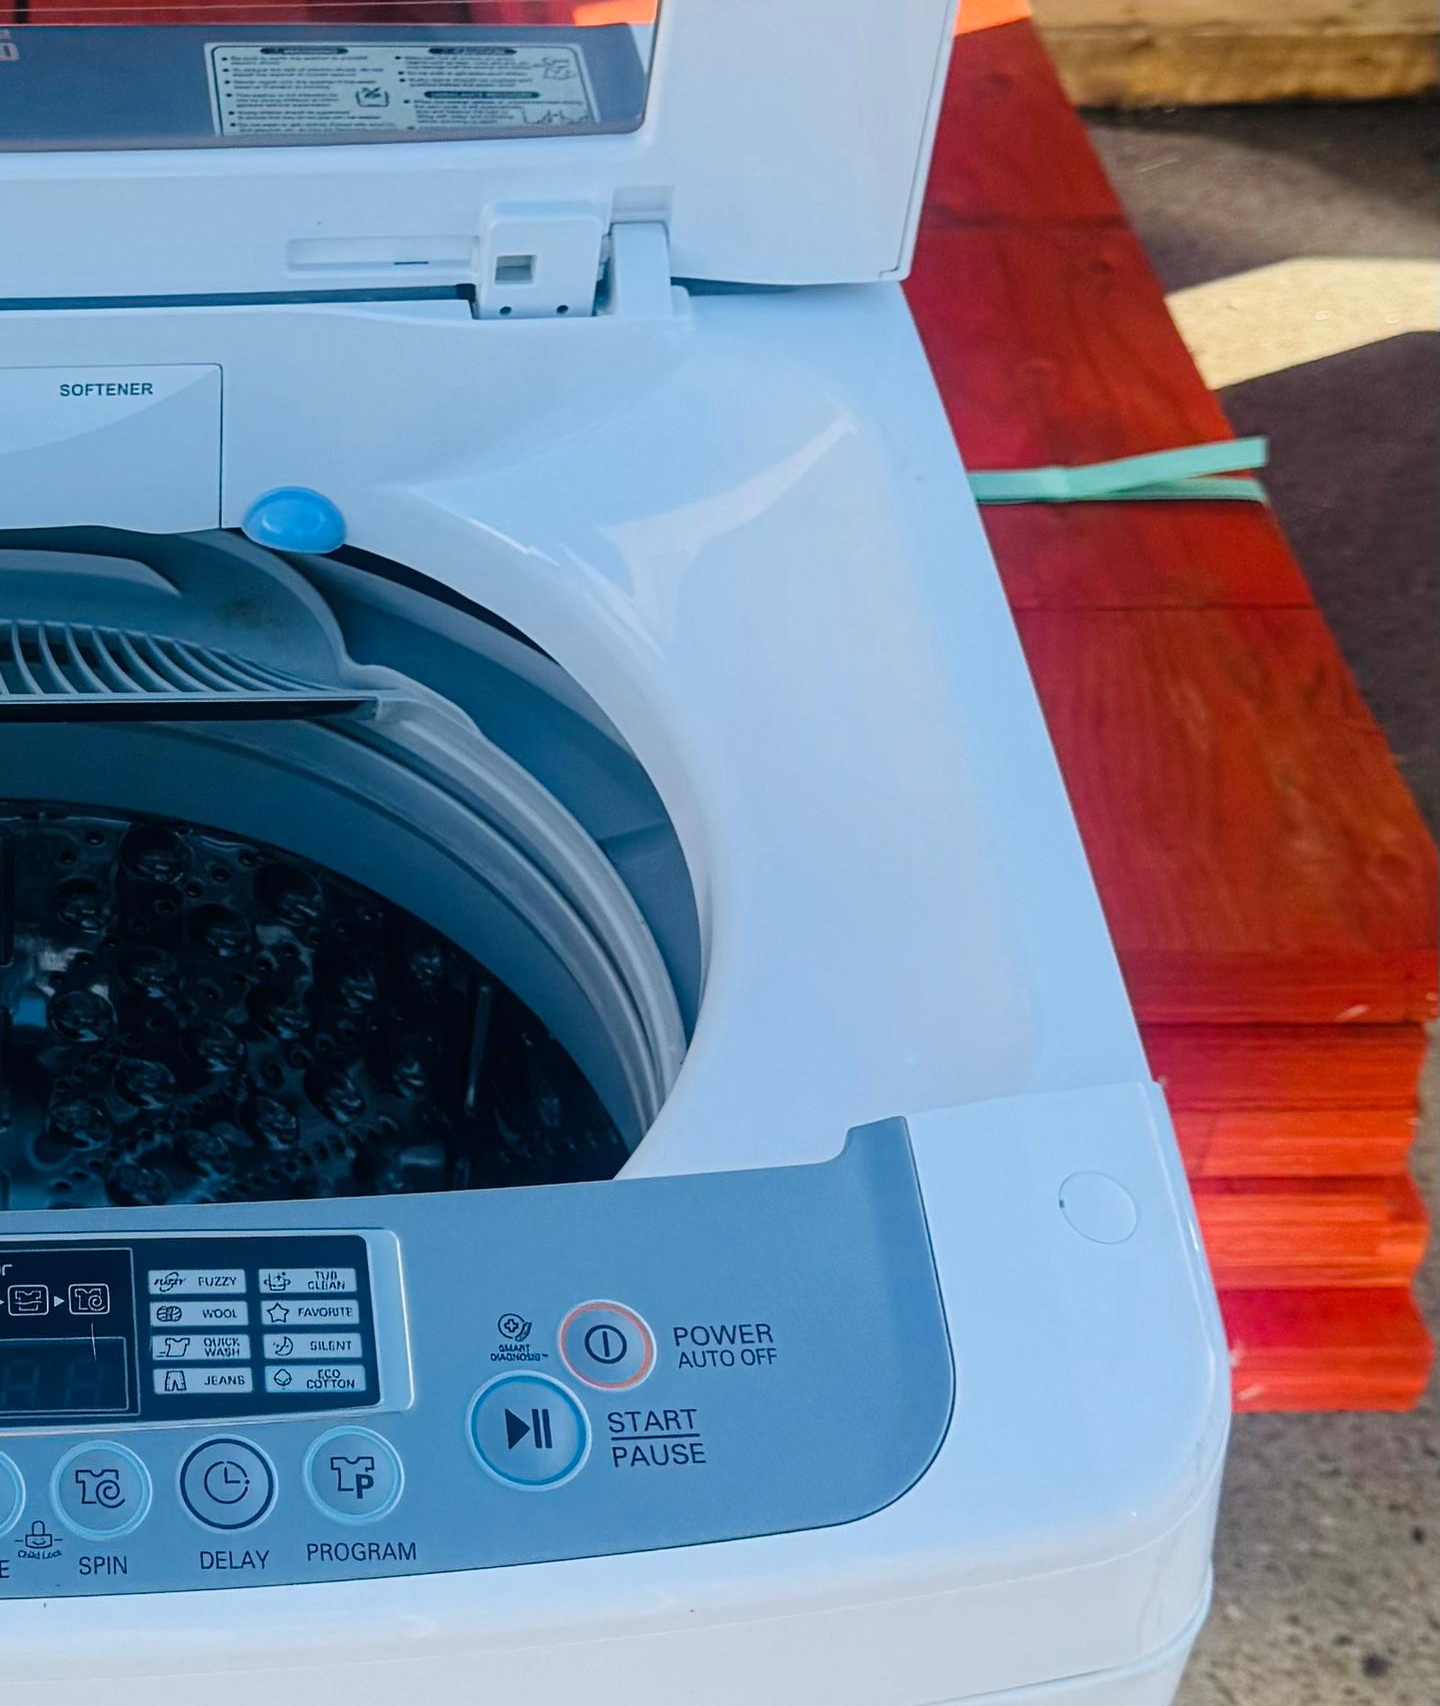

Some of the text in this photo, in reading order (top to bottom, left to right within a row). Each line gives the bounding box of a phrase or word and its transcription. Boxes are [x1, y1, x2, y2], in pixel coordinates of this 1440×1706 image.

[59, 382, 154, 397] SOFTENER
[198, 1276, 237, 1287] FUZZY
[202, 1309, 238, 1319] WOOL
[298, 1307, 353, 1318] FAVORITE
[673, 1323, 774, 1347] POWER
[203, 1338, 240, 1347] QUICK
[310, 1341, 352, 1352] SILENT
[204, 1347, 240, 1357] WASH
[678, 1347, 778, 1369] AUTO OFF
[204, 1375, 246, 1386] JEANS
[306, 1378, 355, 1390] COTTON
[607, 1408, 697, 1434] START
[611, 1443, 707, 1468] PAUSE
[306, 1542, 417, 1563] PROGRAM
[78, 1556, 128, 1576] SPIN
[200, 1550, 270, 1571] DELAY
